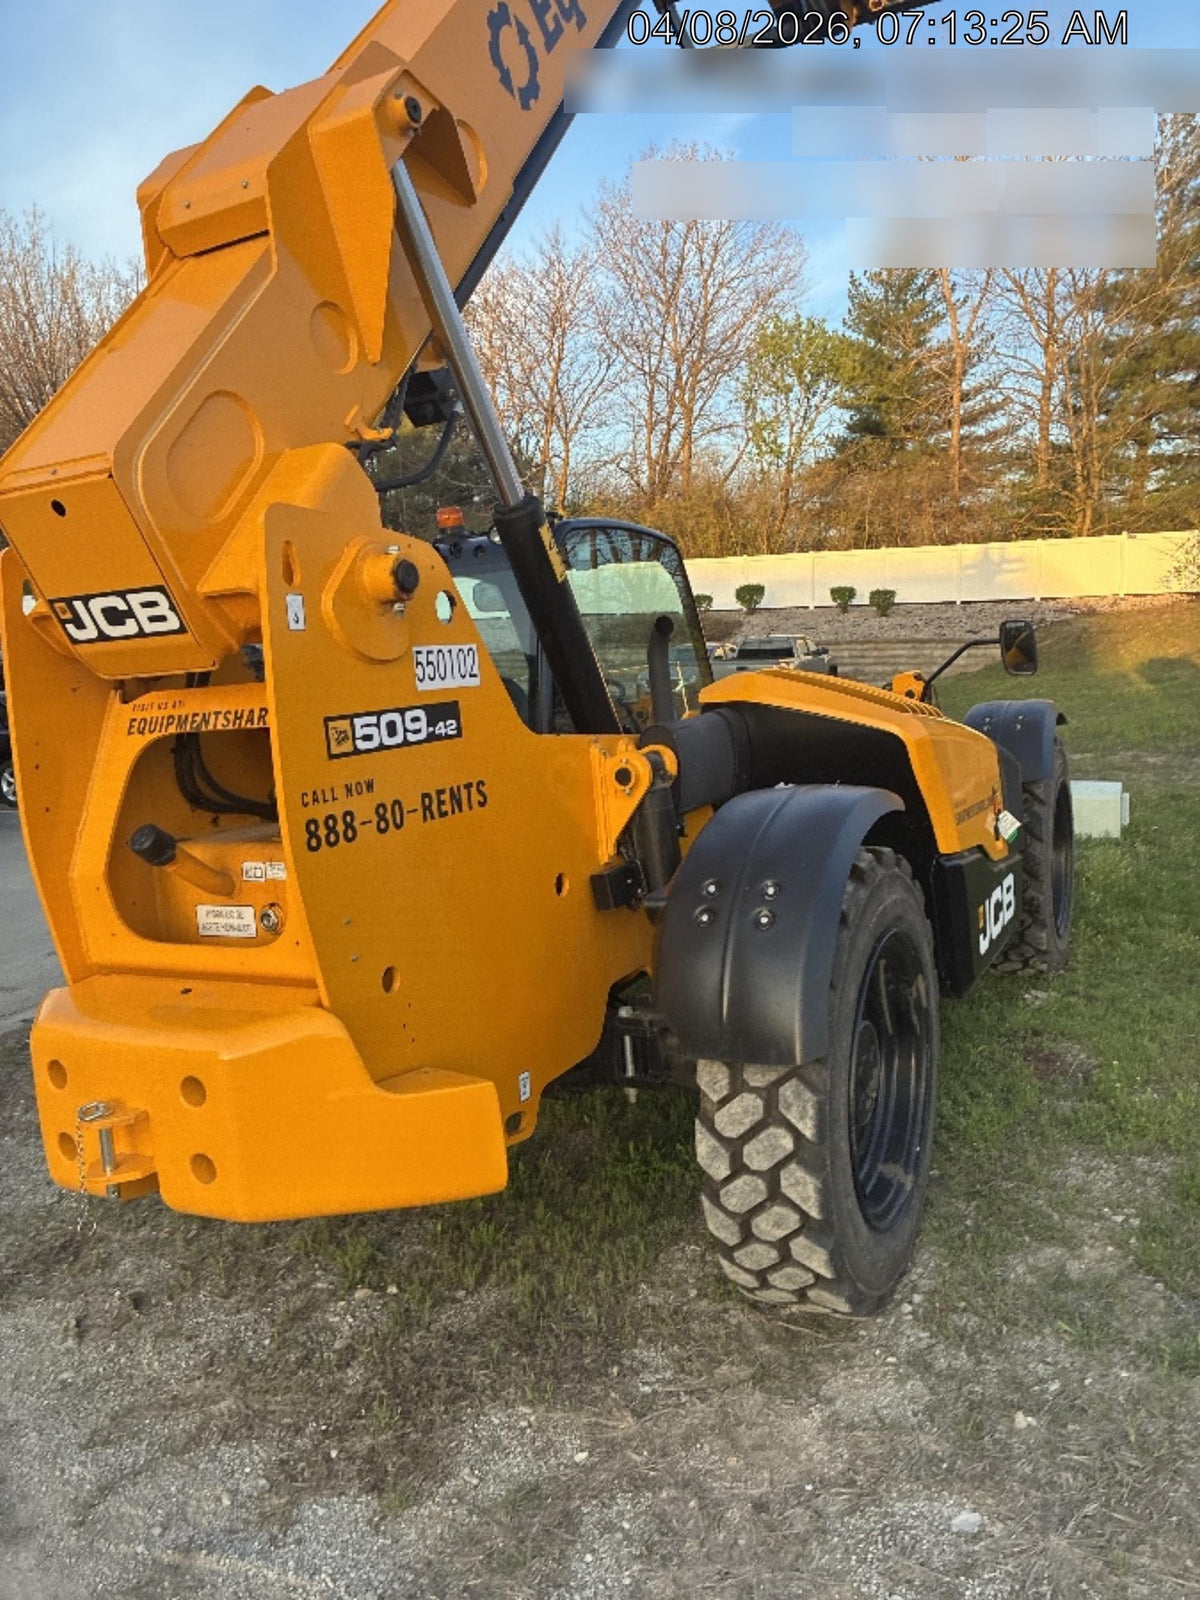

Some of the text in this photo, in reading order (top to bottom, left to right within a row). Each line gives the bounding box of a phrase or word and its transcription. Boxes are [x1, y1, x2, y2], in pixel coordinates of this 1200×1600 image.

[65, 591, 180, 640] JCB
[415, 647, 478, 682] 550102
[301, 779, 375, 808] CALL NOW
[305, 780, 488, 852] 888-80-RENTS
[979, 872, 1015, 956] JCB
